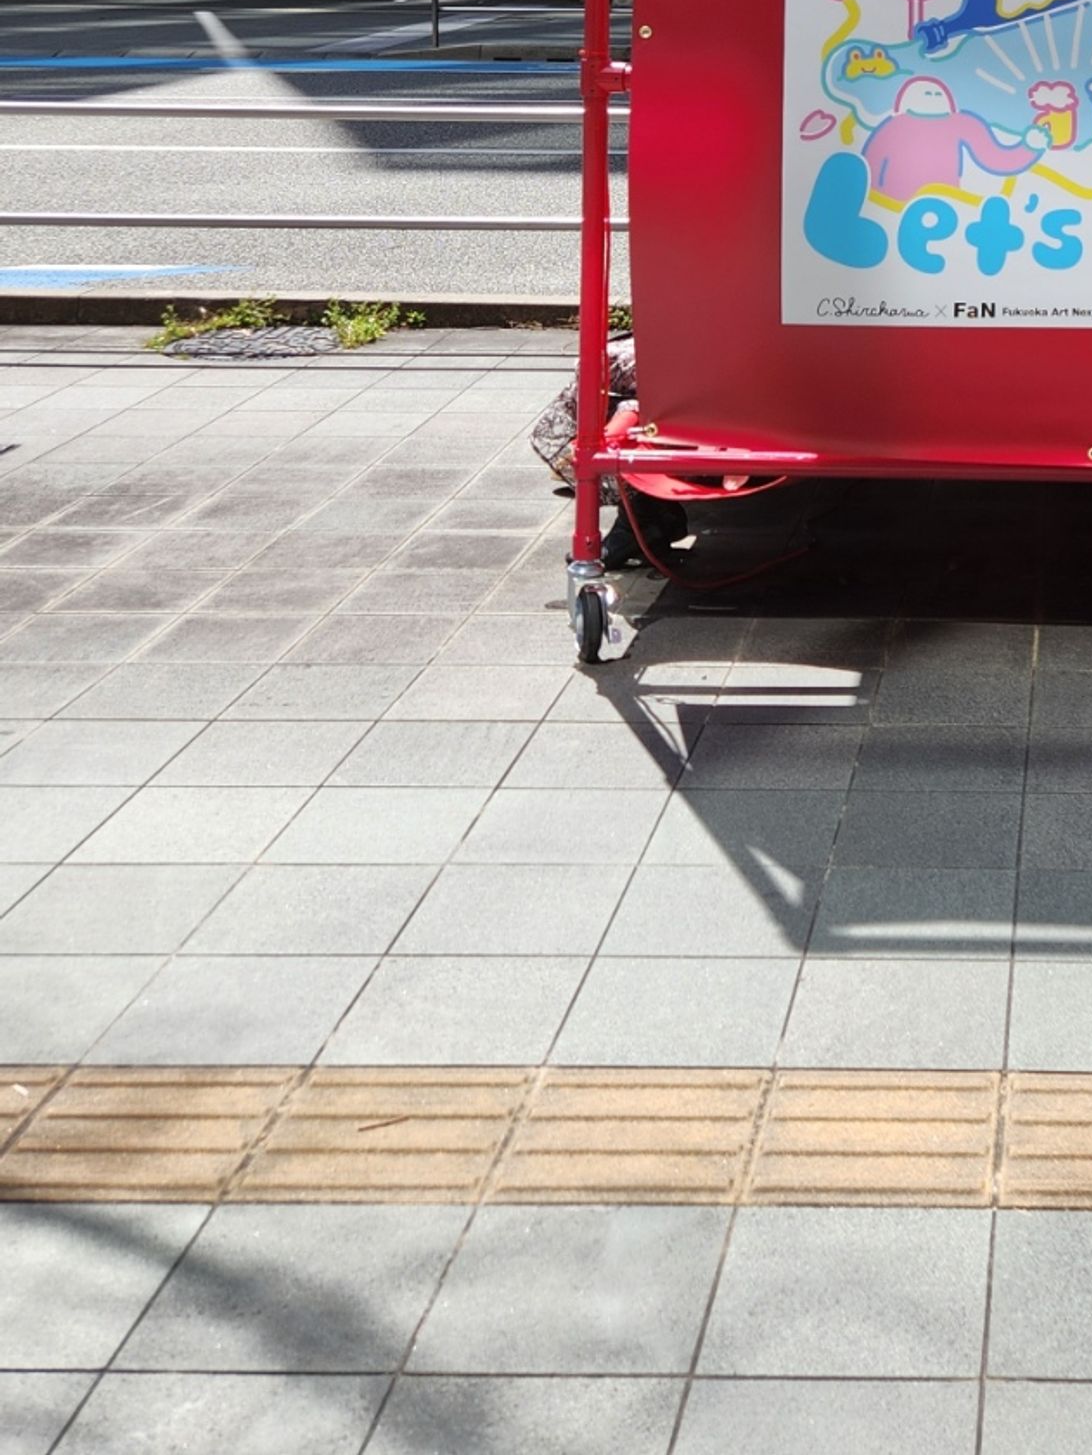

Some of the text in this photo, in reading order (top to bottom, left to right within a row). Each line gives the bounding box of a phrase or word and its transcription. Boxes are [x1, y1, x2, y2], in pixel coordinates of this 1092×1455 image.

[804, 151, 1084, 276] Let's
[953, 302, 996, 318] FaN
[1002, 306, 1049, 318] Fukuoka
[1051, 306, 1069, 317] Art
